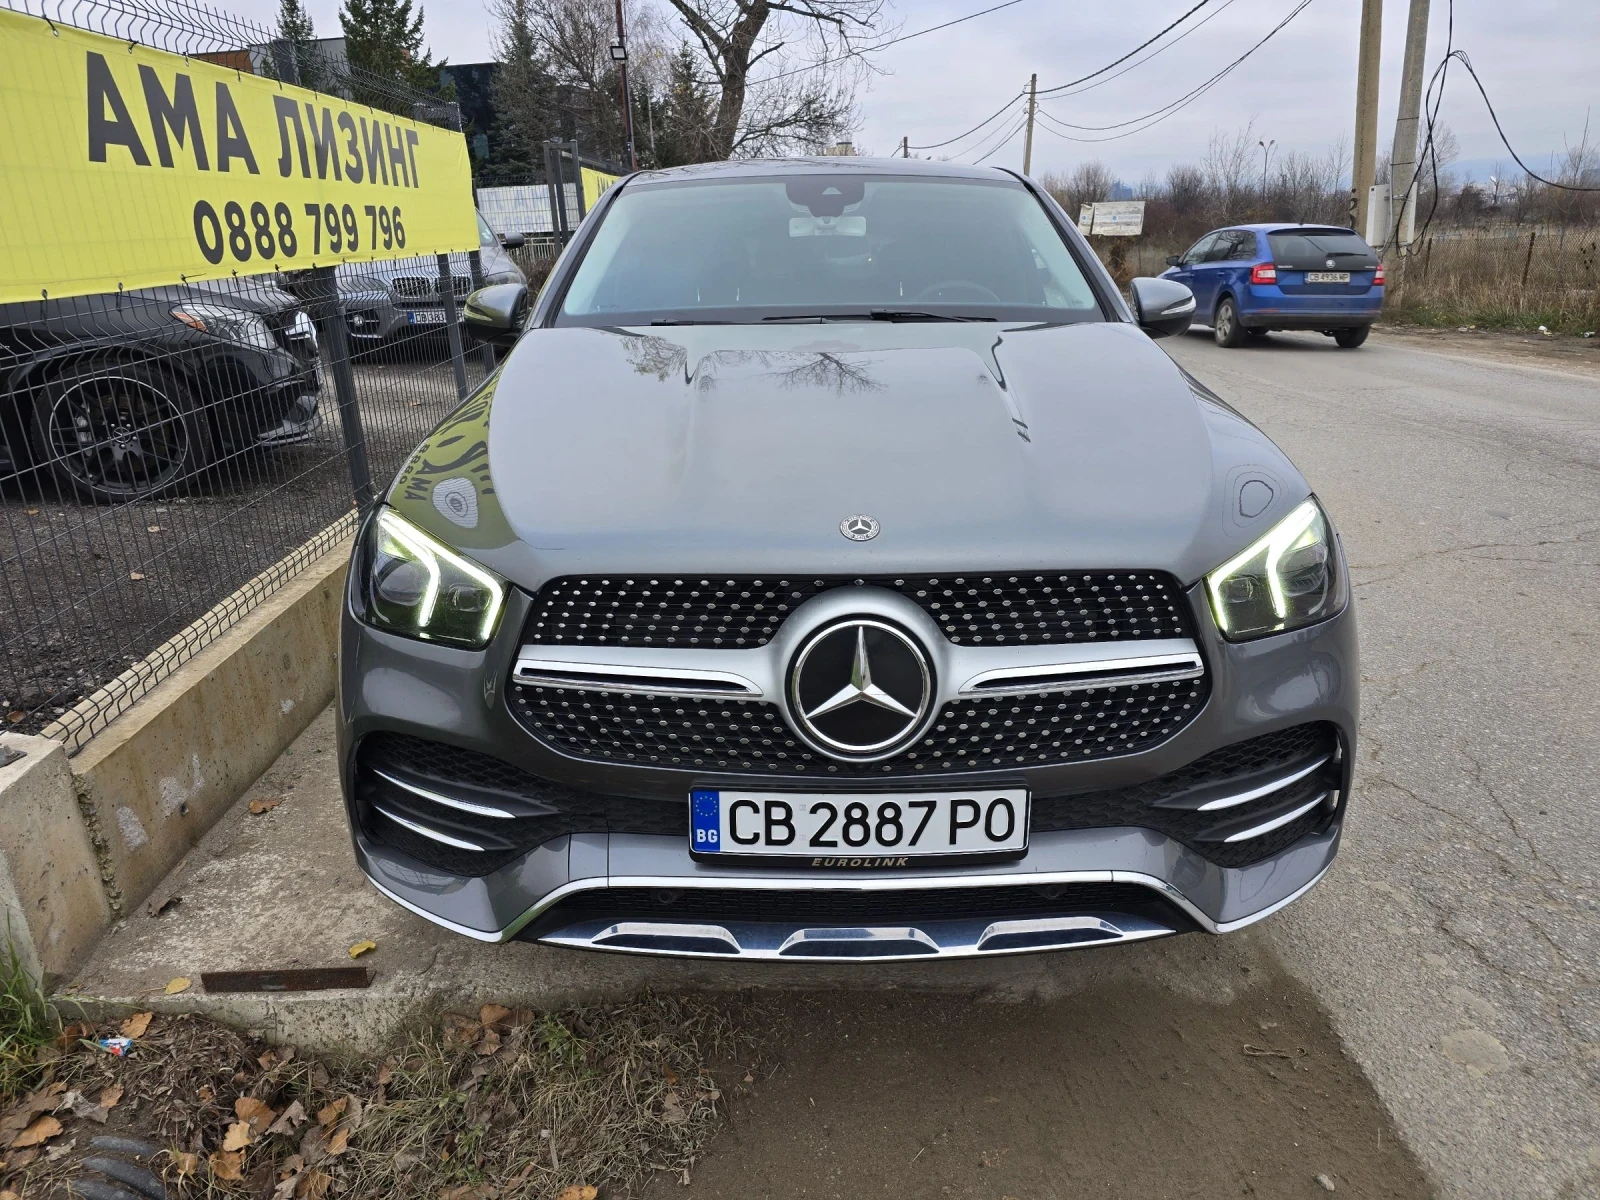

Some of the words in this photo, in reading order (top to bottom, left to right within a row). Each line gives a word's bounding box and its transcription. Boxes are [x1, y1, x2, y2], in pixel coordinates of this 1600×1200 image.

[86, 50, 260, 175] АМА
[273, 94, 419, 189] ЛИЗИНГ
[193, 200, 297, 265] 0888
[304, 203, 359, 255] 799
[364, 205, 406, 251] 796
[696, 828, 718, 843] BG
[729, 799, 796, 846] CB
[808, 800, 937, 847] 2887
[949, 797, 1015, 845] PO
[811, 857, 909, 867] EUROLINK
